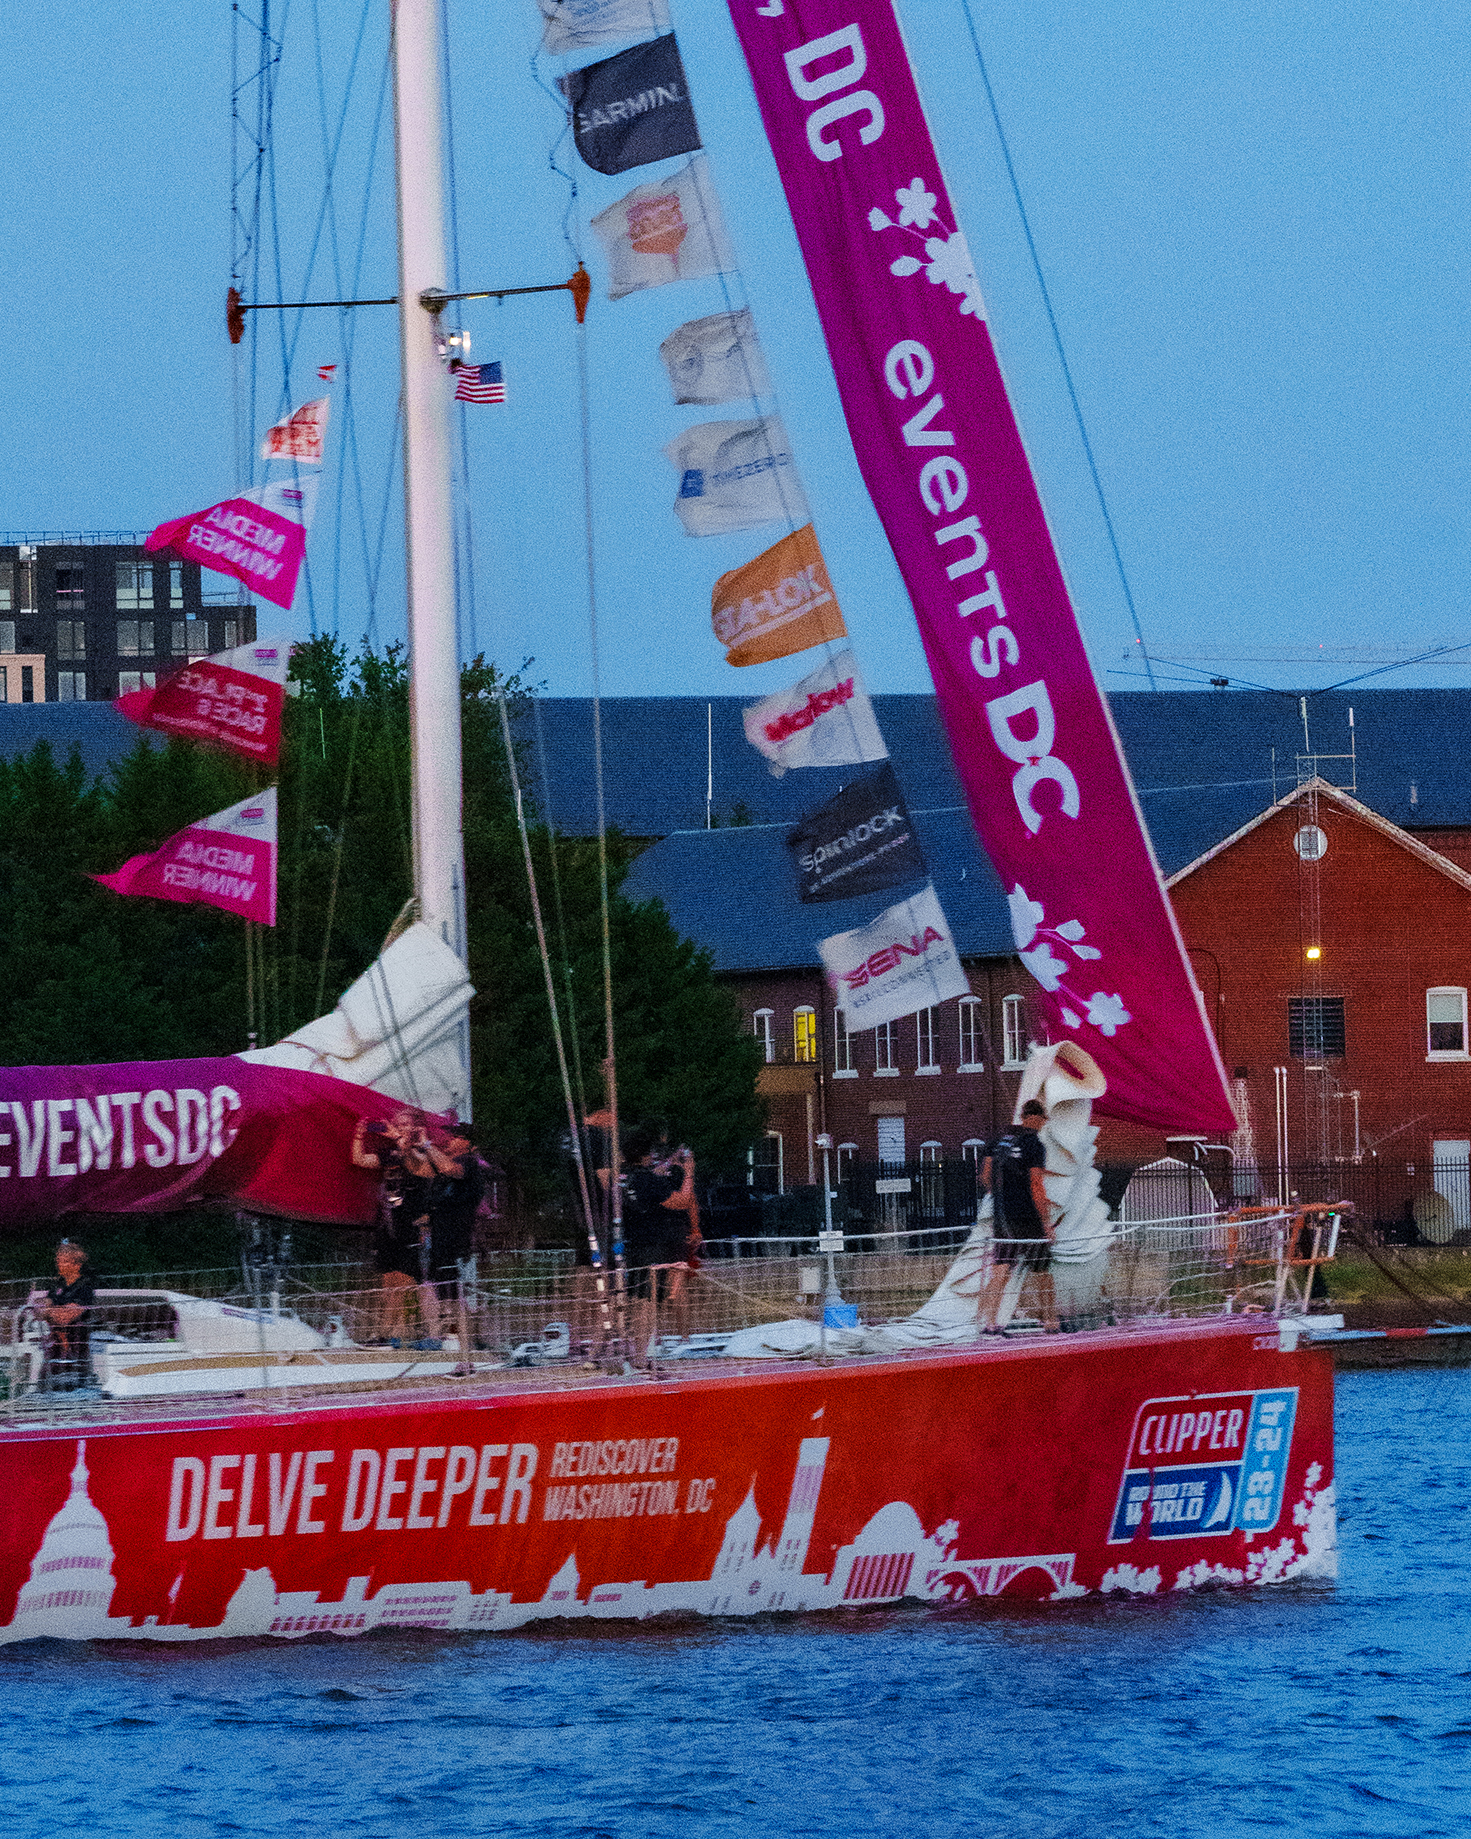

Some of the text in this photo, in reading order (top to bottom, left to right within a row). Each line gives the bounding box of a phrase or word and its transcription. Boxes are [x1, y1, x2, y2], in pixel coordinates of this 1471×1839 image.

[784, 22, 886, 162] DC
[840, 925, 945, 990] SENA
[549, 1437, 680, 1478] REDISCOVER
[1139, 1409, 1244, 1455] CLIPPER
[1242, 1401, 1287, 1521] 23-24
[166, 1443, 538, 1543] DELVE DEEPER
[686, 1478, 716, 1514] DC
